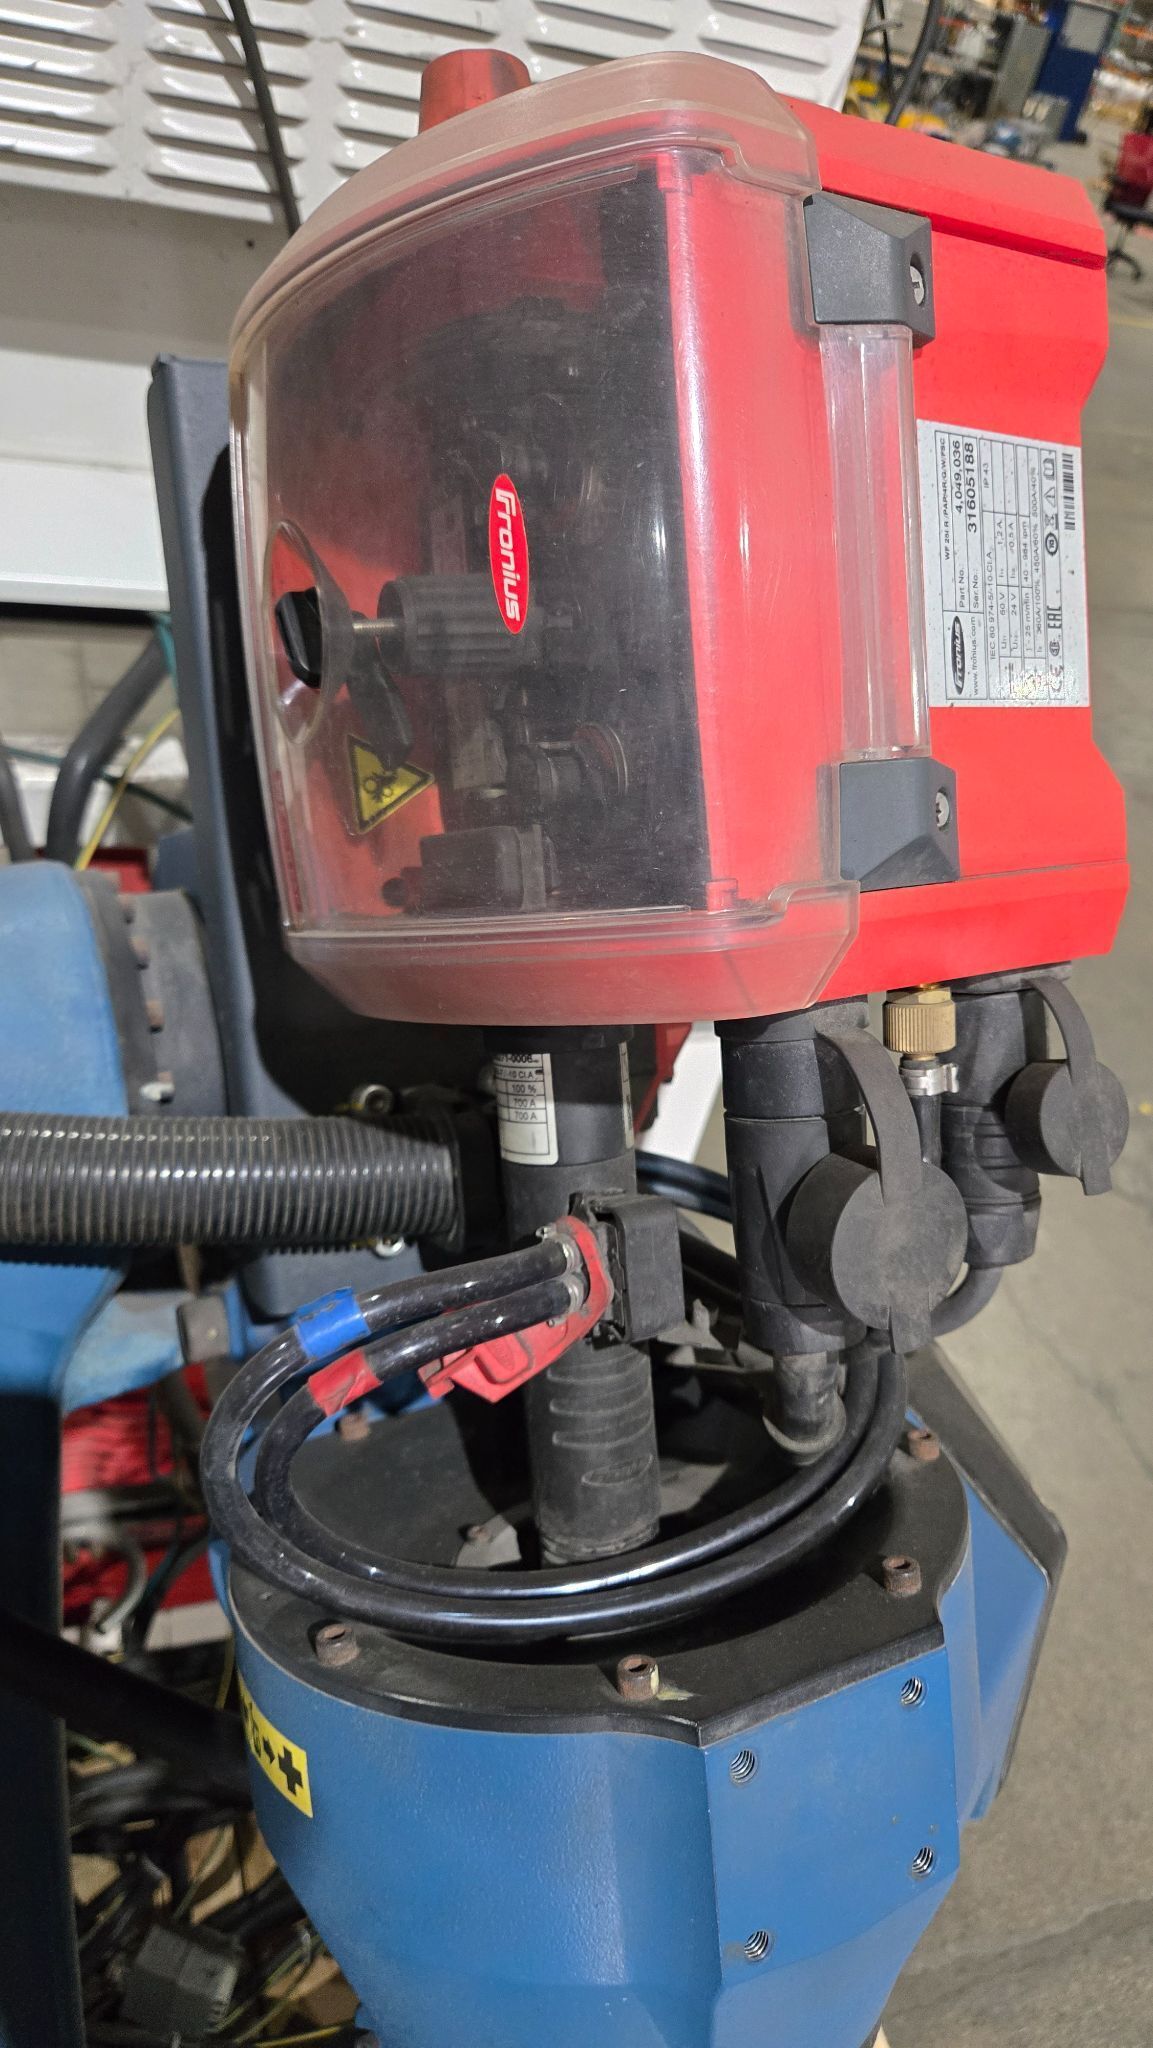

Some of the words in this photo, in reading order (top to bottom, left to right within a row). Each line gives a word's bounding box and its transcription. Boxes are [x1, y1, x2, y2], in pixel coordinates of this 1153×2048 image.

[983, 463, 988, 475] 43
[953, 440, 963, 514] 4,049,036
[983, 478, 989, 488] IP
[964, 443, 976, 533] 31605188
[996, 520, 1002, 528] A
[495, 487, 521, 622] Fronius
[944, 547, 950, 560] WF
[1023, 570, 1029, 582] 40
[999, 592, 1005, 600] V
[1011, 605, 1017, 616] 24
[1025, 625, 1031, 637] 25
[953, 620, 963, 690] Fronius
[970, 617, 978, 695] www.fronius.com
[512, 1084, 526, 1093] 100
[527, 1084, 537, 1094] %
[530, 1098, 537, 1108] A
[530, 1111, 538, 1121] A
